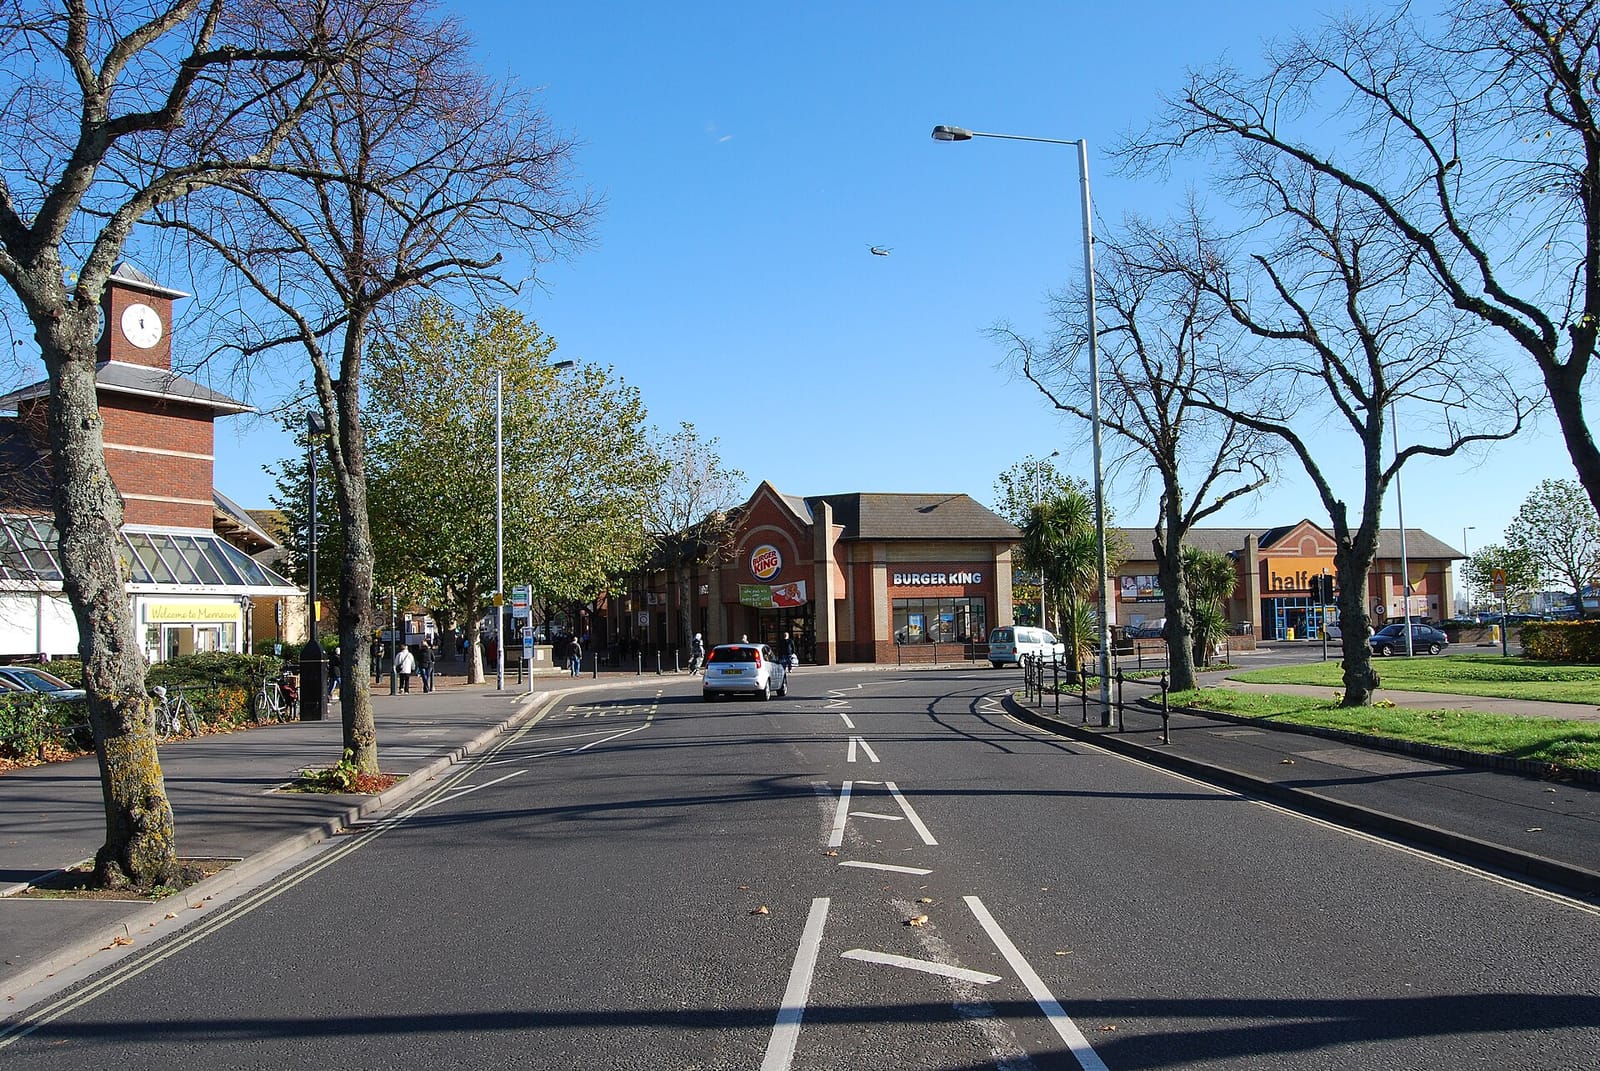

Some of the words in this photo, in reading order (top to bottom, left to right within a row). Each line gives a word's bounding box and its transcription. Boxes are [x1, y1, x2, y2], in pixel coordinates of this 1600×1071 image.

[752, 550, 777, 566] BURGER
[754, 556, 778, 575] KING
[893, 573, 947, 585] BURGER
[948, 572, 982, 584] KING
[152, 605, 188, 619] Welcome
[188, 608, 197, 619] to
[197, 607, 237, 620] Morrisons
